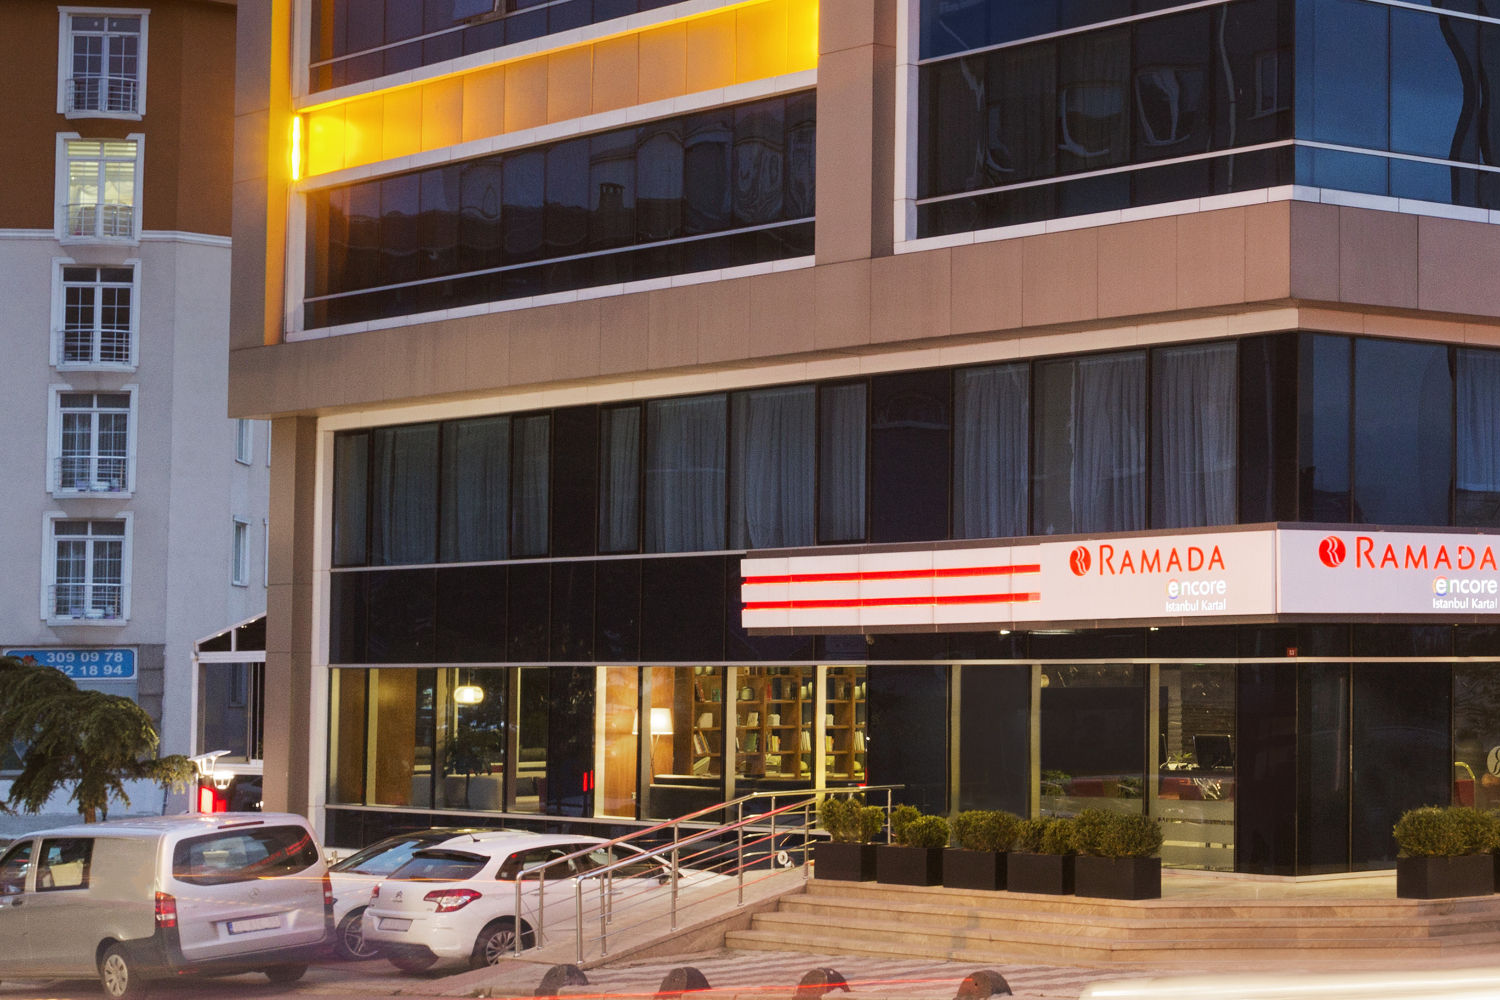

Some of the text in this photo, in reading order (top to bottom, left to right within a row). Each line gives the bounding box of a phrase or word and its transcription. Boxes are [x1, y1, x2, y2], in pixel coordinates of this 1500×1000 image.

[1099, 544, 1226, 576] RAMADA
[1355, 536, 1499, 571] RAMADA
[1166, 578, 1226, 599] encore
[1432, 576, 1498, 597] encore
[1201, 598, 1227, 611] Kartal
[1471, 597, 1498, 609] Kartal
[46, 651, 124, 663] 309 09 78
[80, 665, 98, 676] 18
[103, 664, 123, 675] 94
